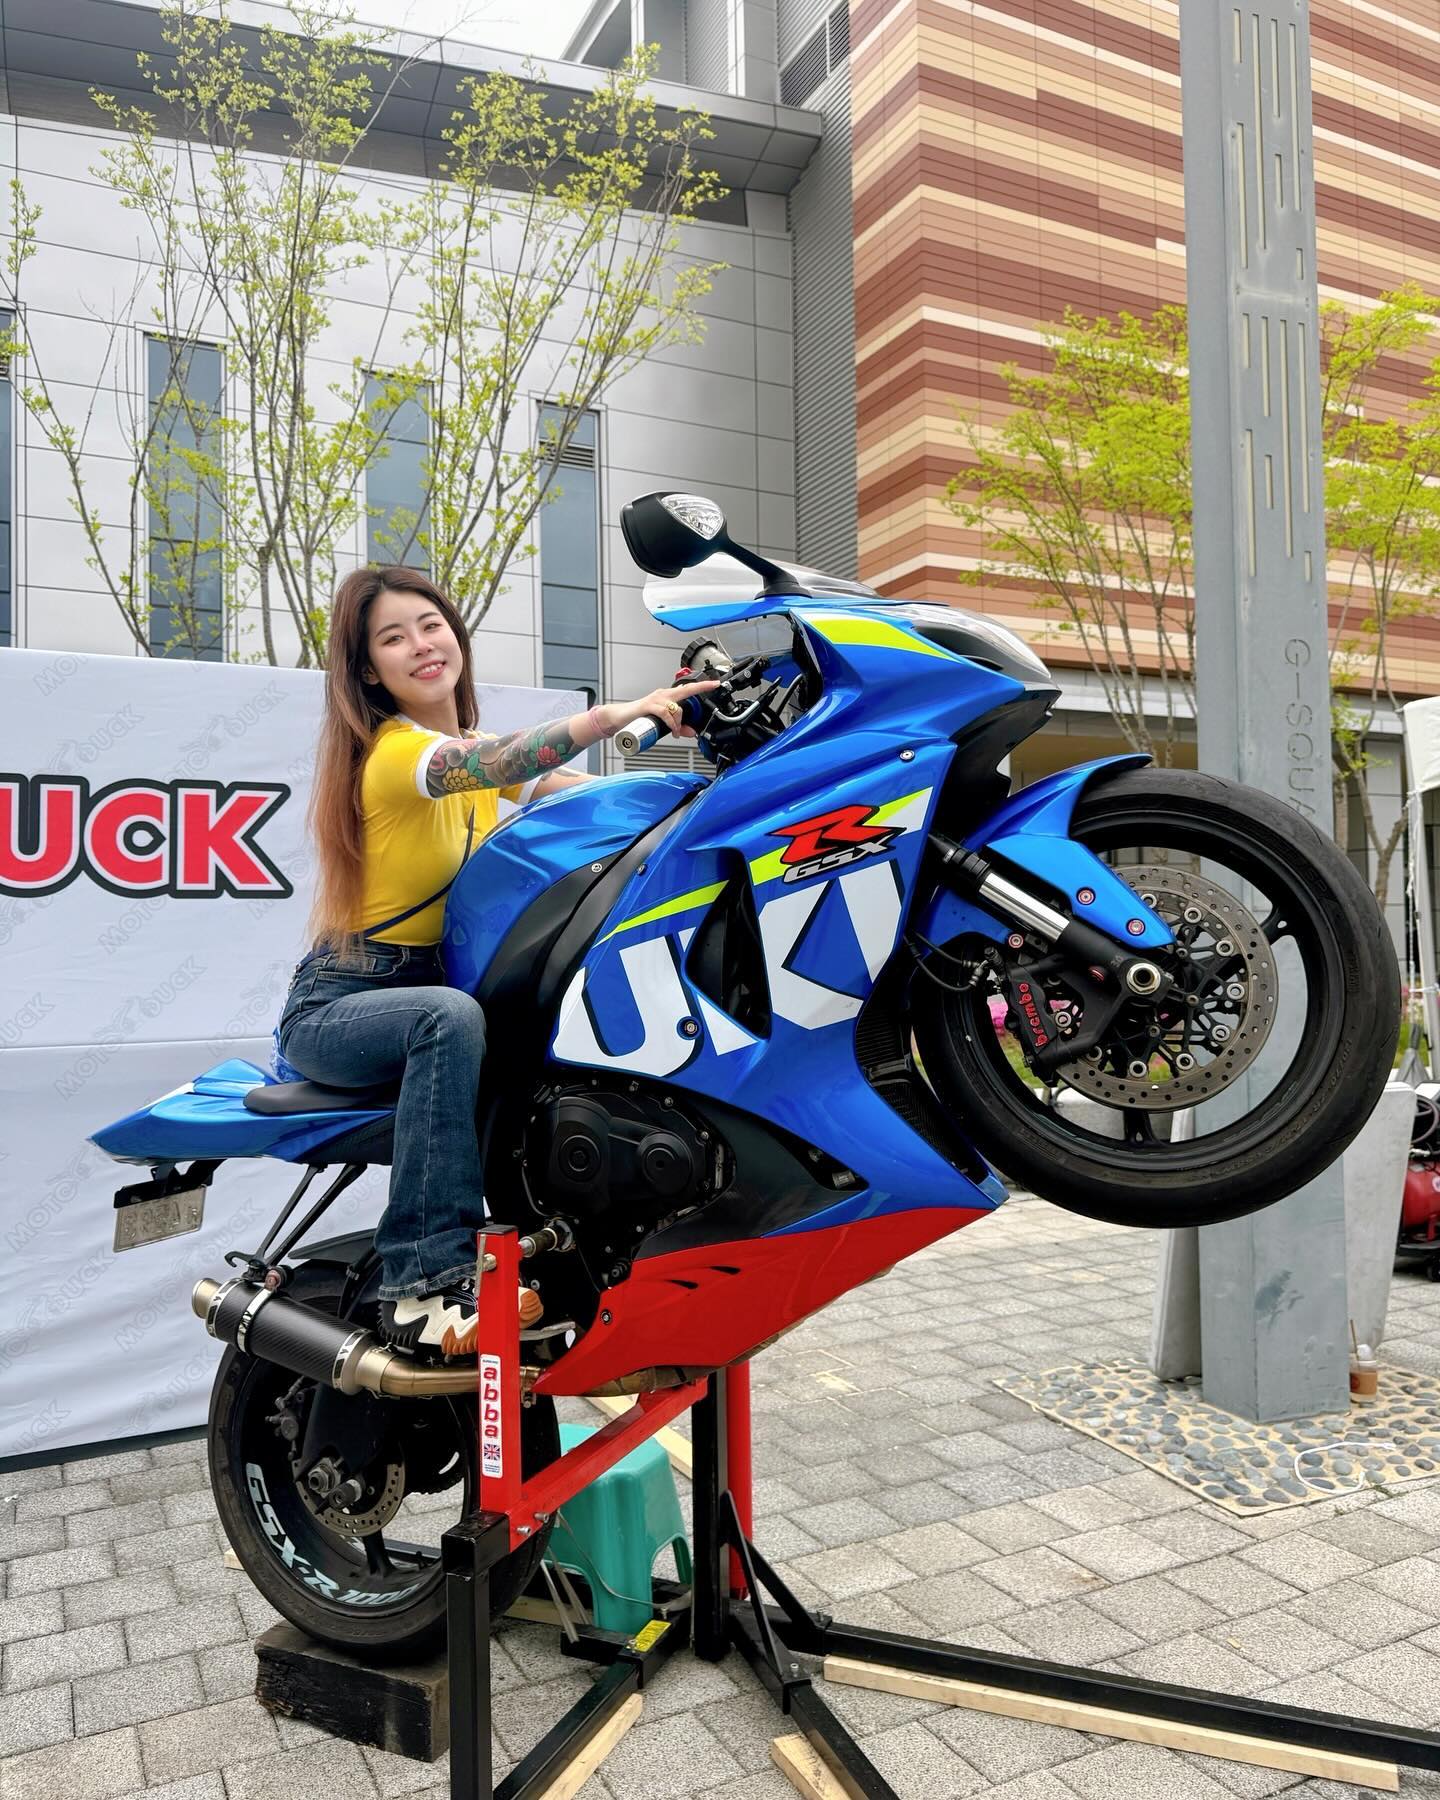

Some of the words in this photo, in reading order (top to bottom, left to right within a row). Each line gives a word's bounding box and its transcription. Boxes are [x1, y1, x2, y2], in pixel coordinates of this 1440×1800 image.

[783, 833, 896, 883] GSX
[1018, 983, 1049, 1047] brembo
[12, 1399, 72, 1451] UCK
[484, 1367, 499, 1437] abba
[246, 1462, 340, 1599] GSX-R
